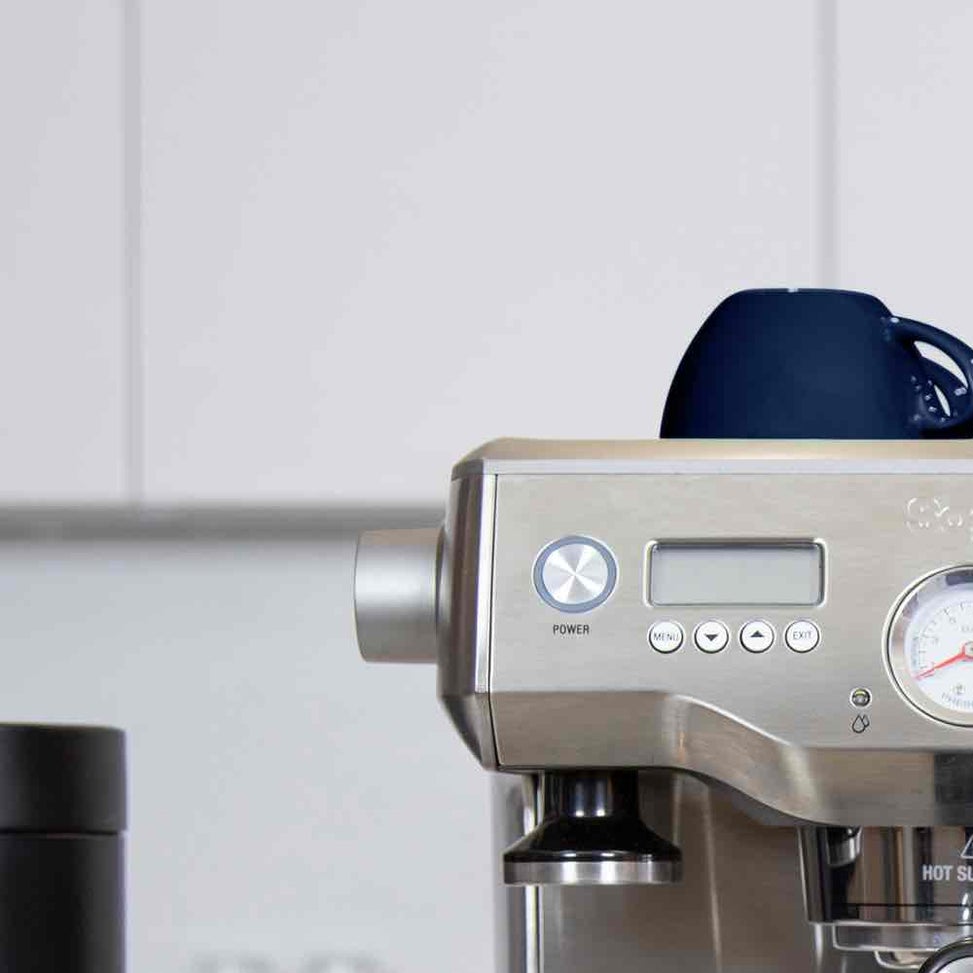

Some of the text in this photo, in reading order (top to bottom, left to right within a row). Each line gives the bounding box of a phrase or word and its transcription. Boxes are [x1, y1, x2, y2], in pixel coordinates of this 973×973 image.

[552, 624, 590, 635] POWER
[653, 631, 679, 641] MENU
[792, 631, 812, 641] EXIT
[922, 864, 953, 881] HOT
